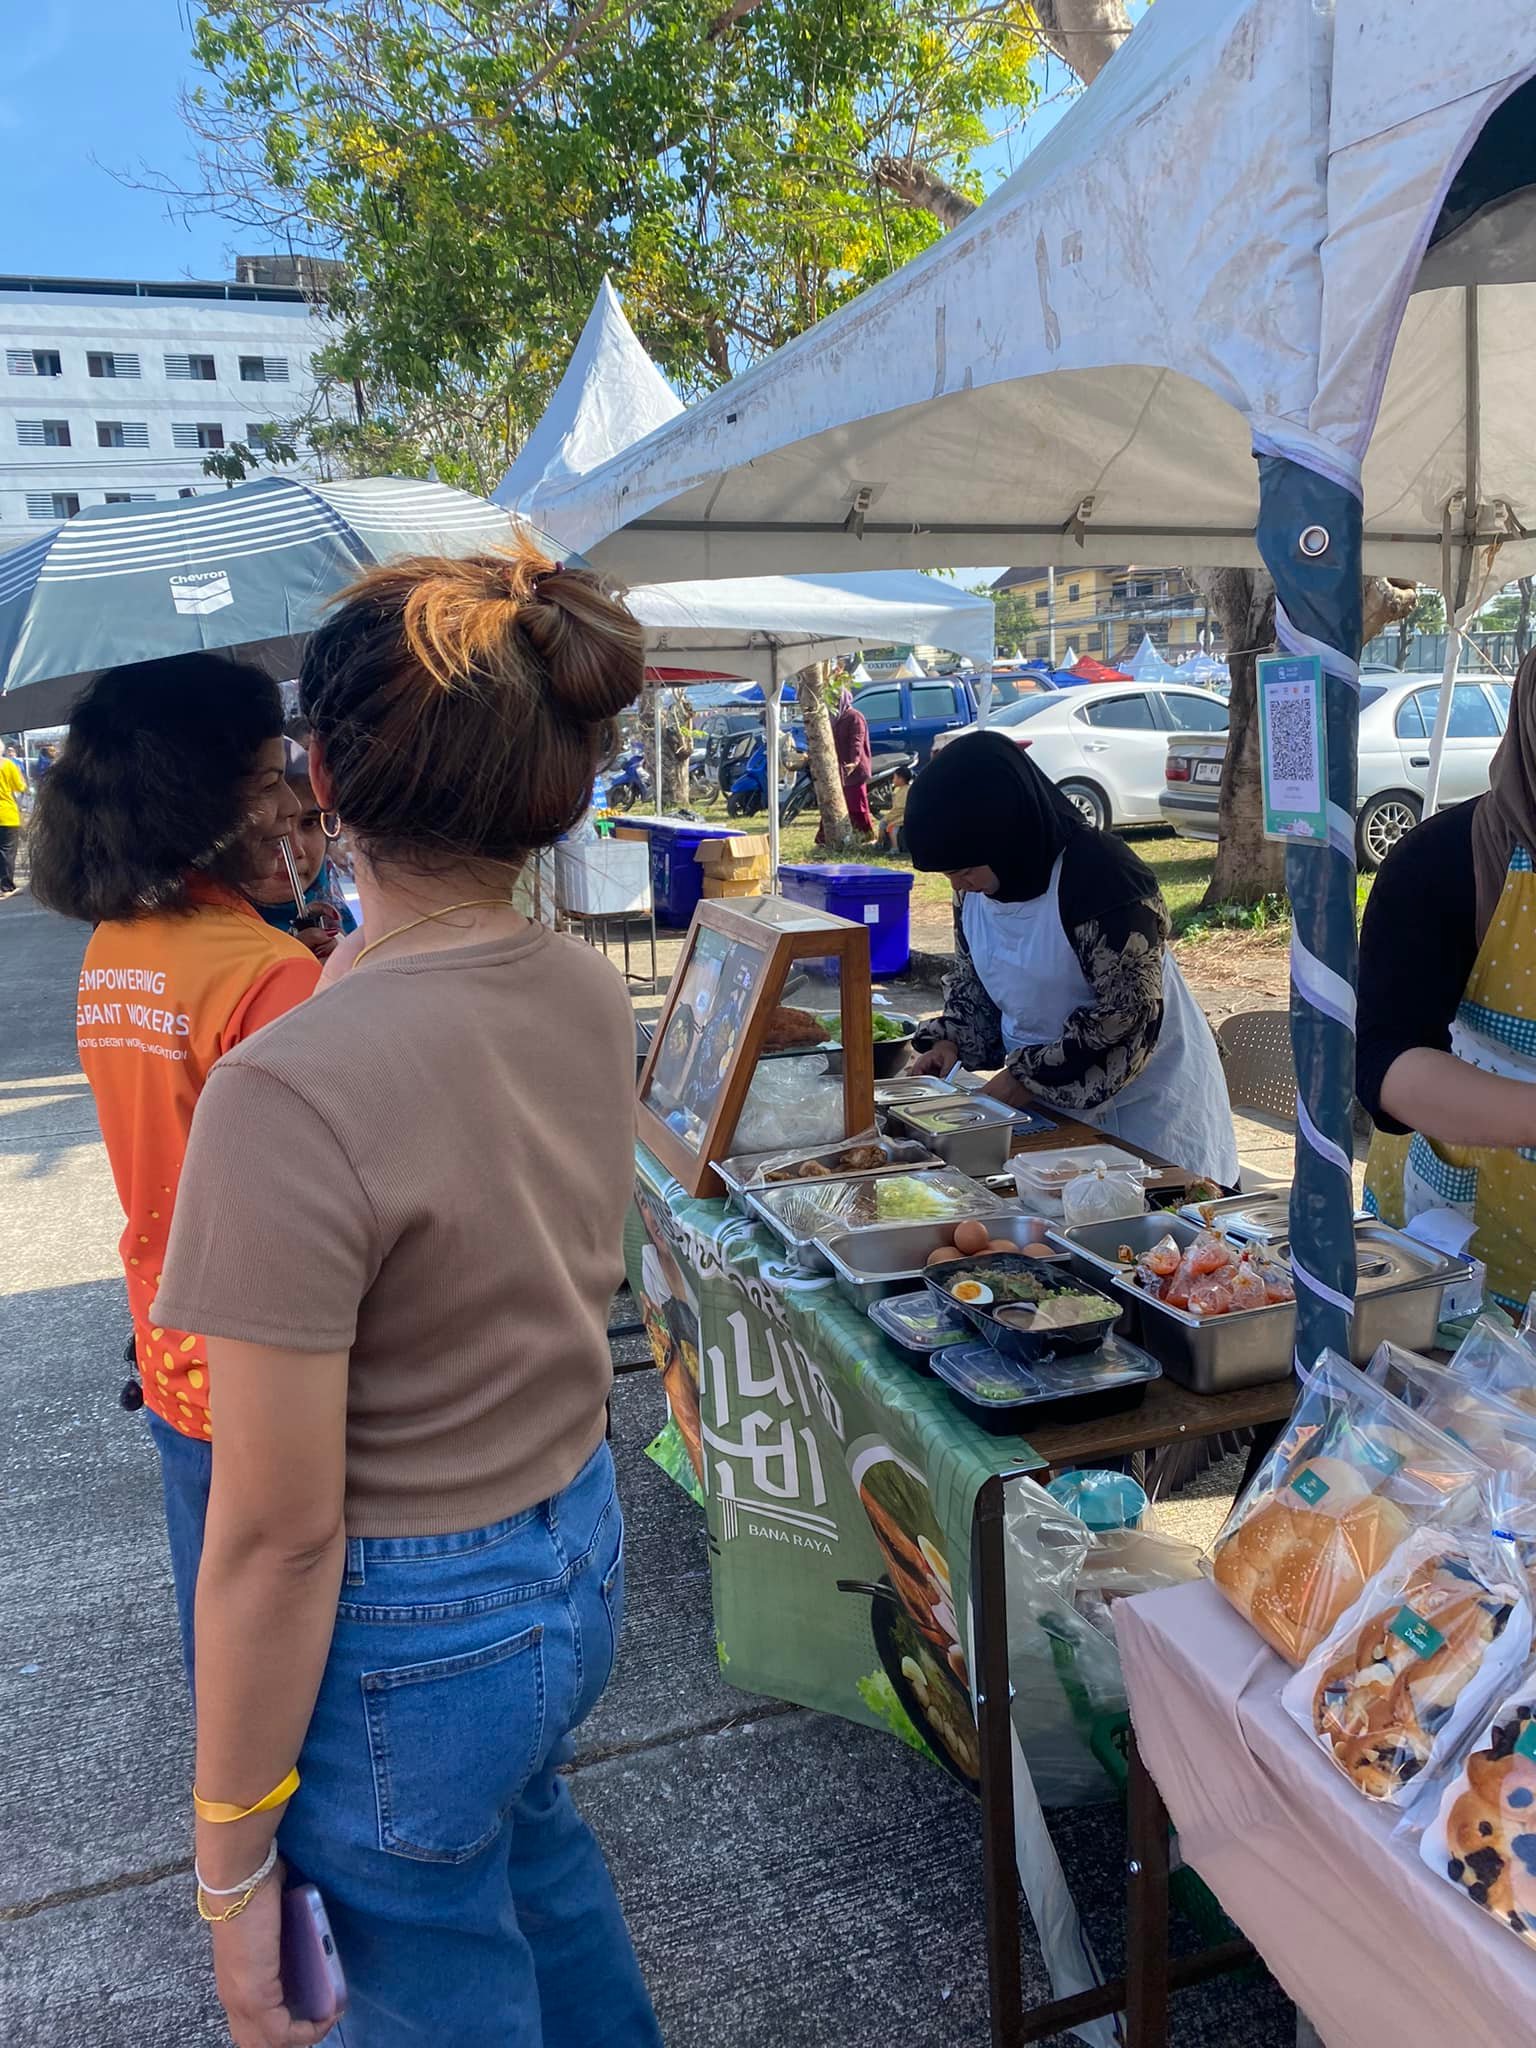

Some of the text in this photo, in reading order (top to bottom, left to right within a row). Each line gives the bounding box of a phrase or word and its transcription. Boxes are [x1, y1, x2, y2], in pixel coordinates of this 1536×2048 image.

[169, 570, 227, 585] Chevron
[748, 1524, 833, 1556] BANA RAYA
